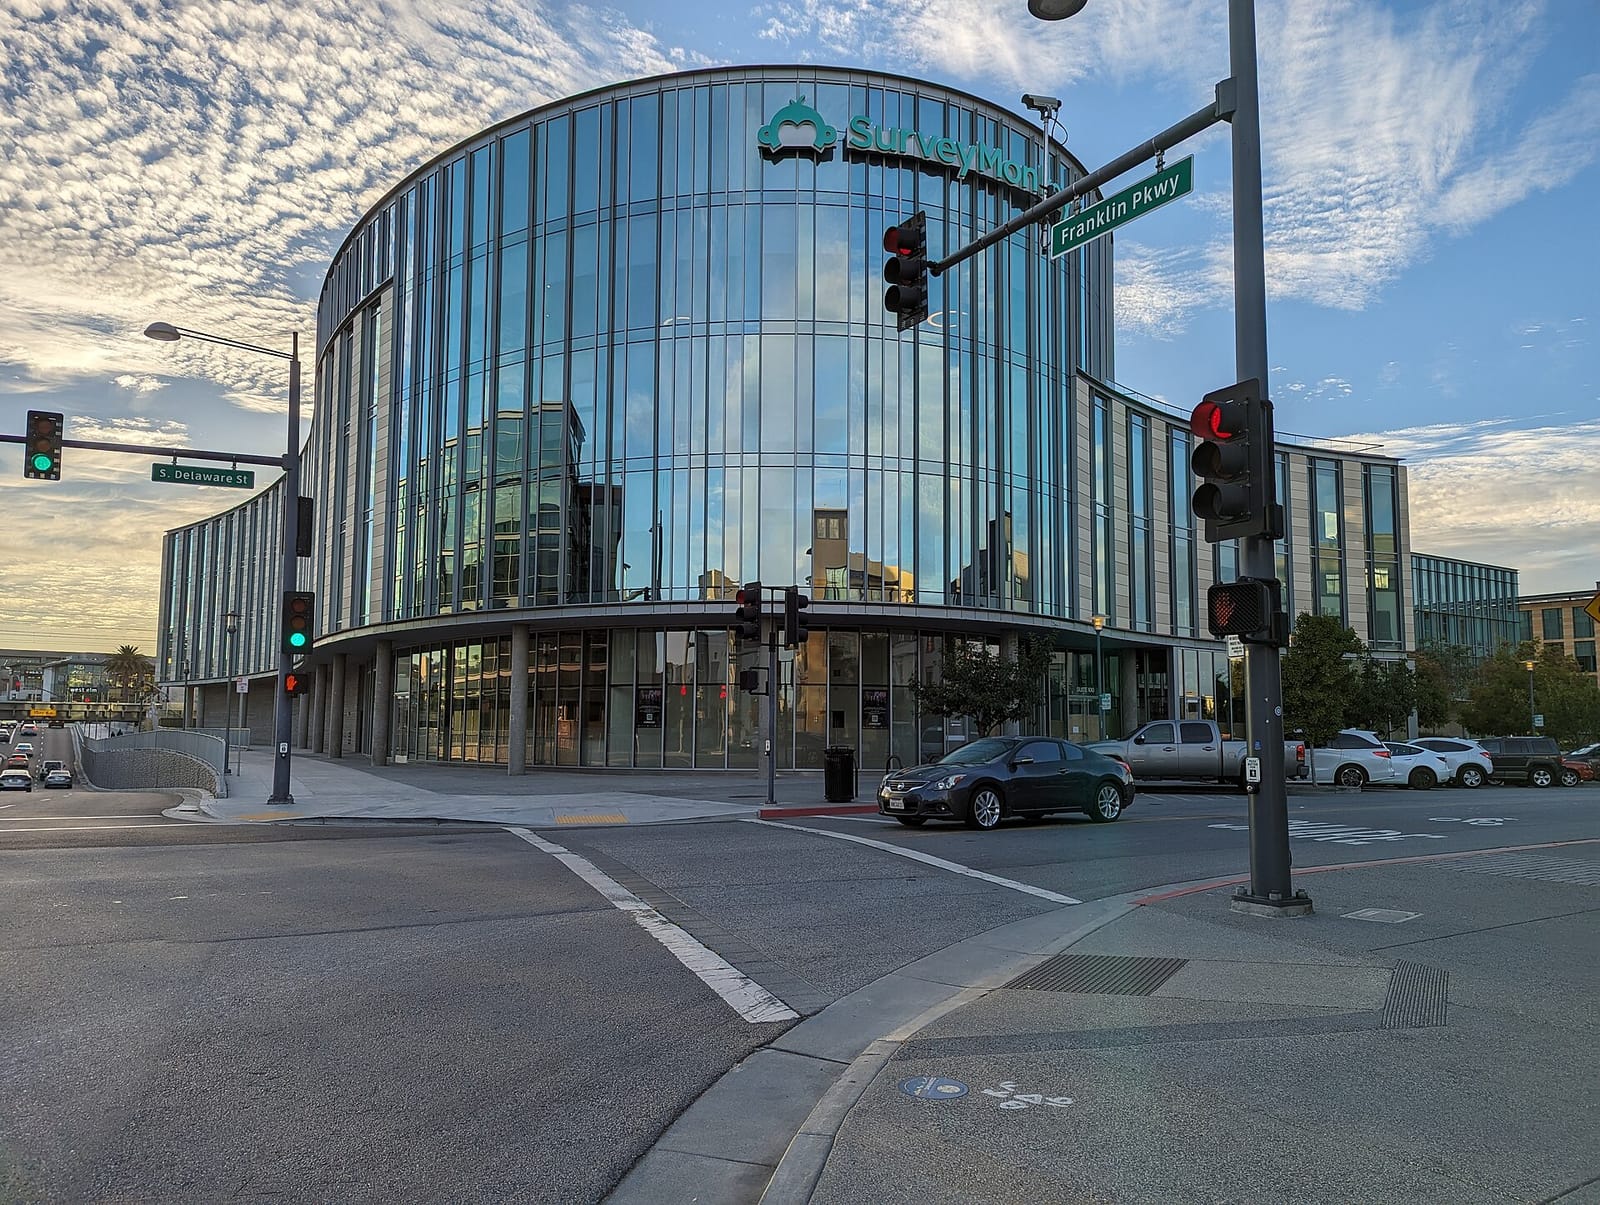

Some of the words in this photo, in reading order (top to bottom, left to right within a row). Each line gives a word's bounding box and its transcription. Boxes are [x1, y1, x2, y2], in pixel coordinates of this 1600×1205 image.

[1061, 203, 1127, 245] Franklin
[1132, 174, 1179, 210] Pkwy
[159, 468, 171, 478] S.
[175, 470, 233, 483] Delaware
[236, 475, 248, 484] St
